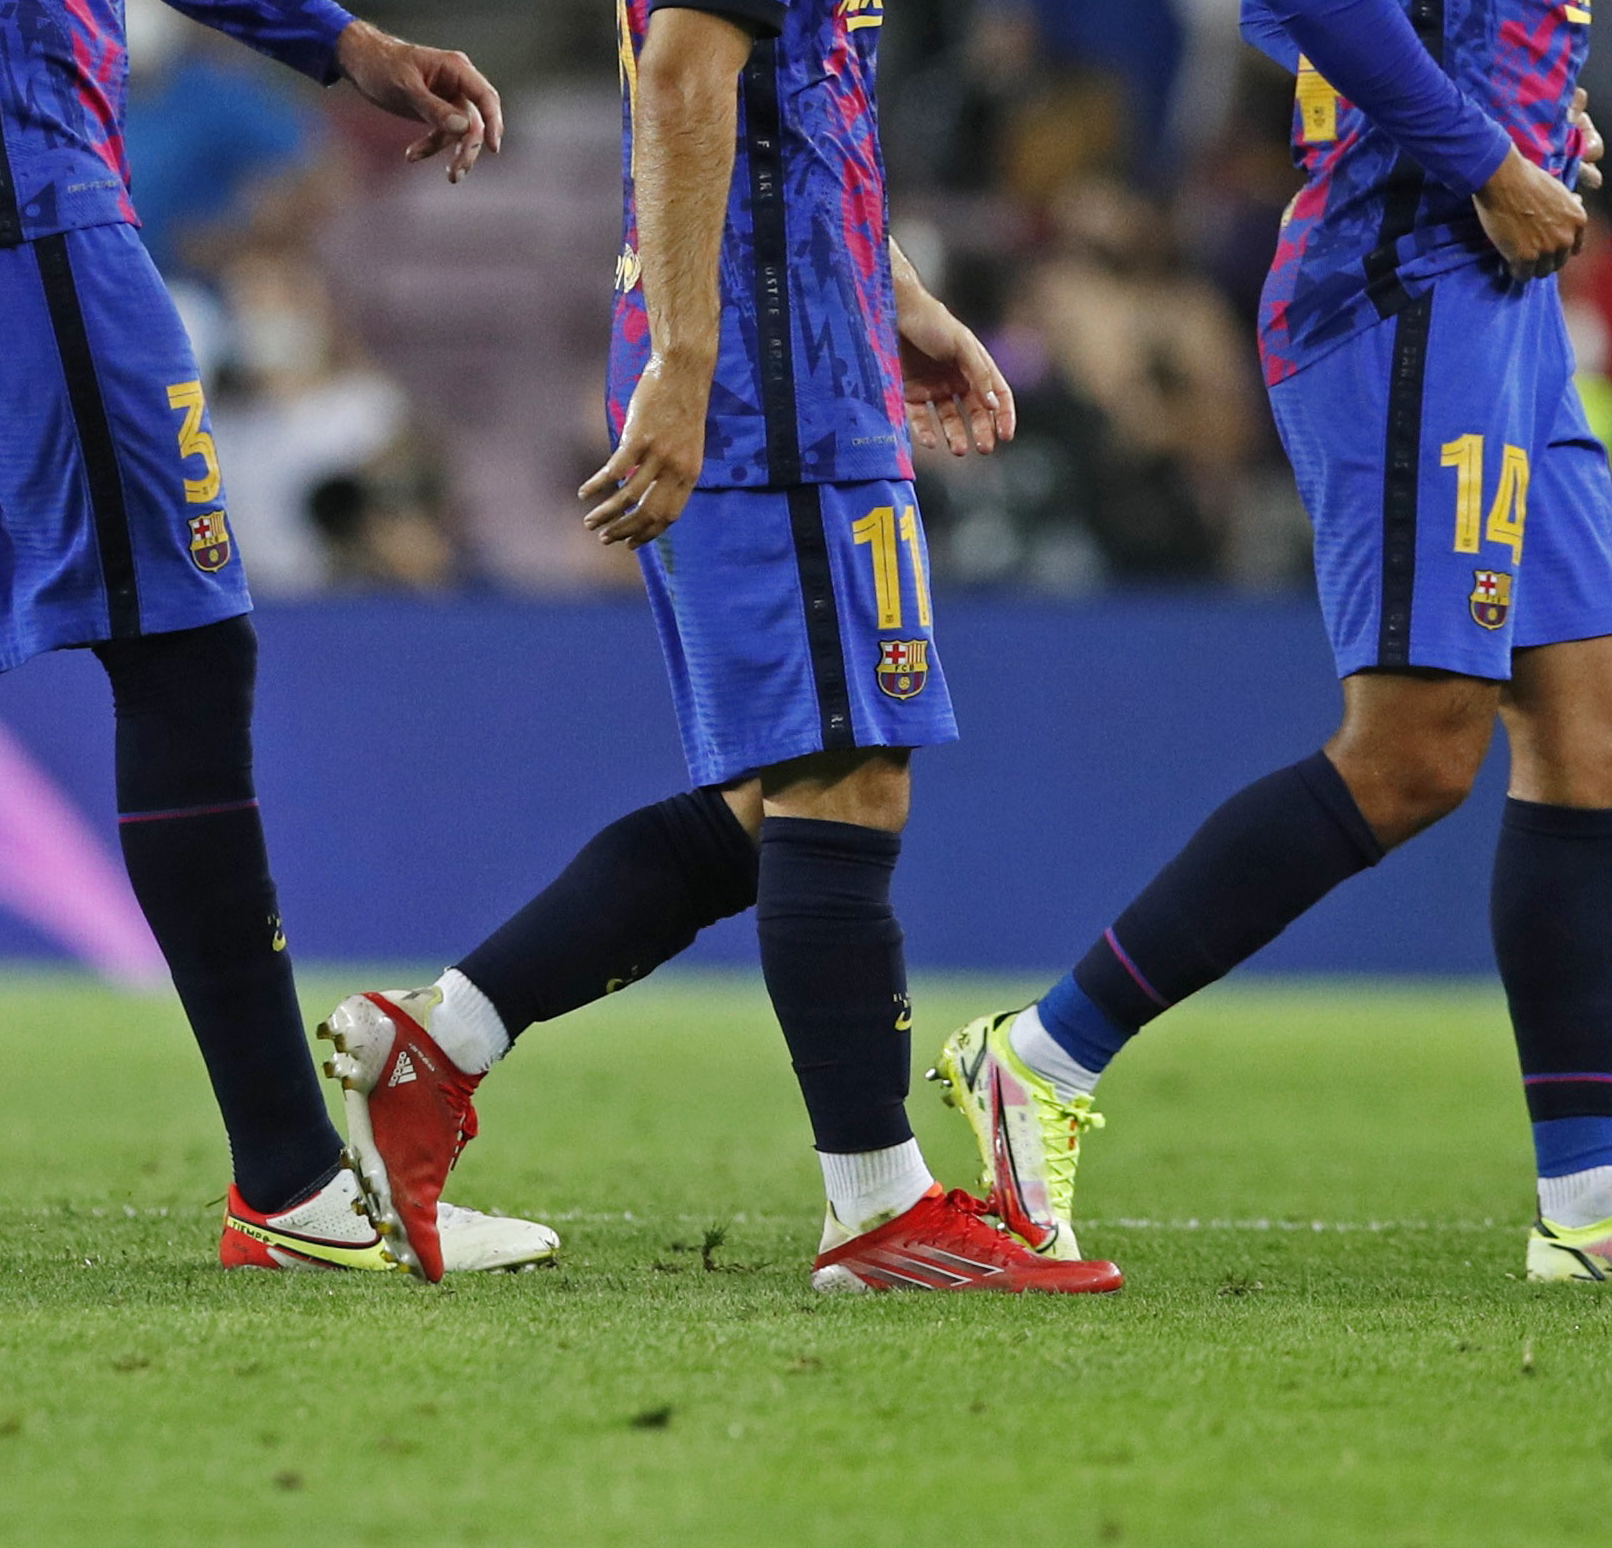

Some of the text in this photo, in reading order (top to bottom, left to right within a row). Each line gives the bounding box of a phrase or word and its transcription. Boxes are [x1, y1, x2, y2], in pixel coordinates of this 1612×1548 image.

[166, 380, 221, 503] 3
[1440, 433, 1531, 566] 14
[852, 505, 931, 629] 11
